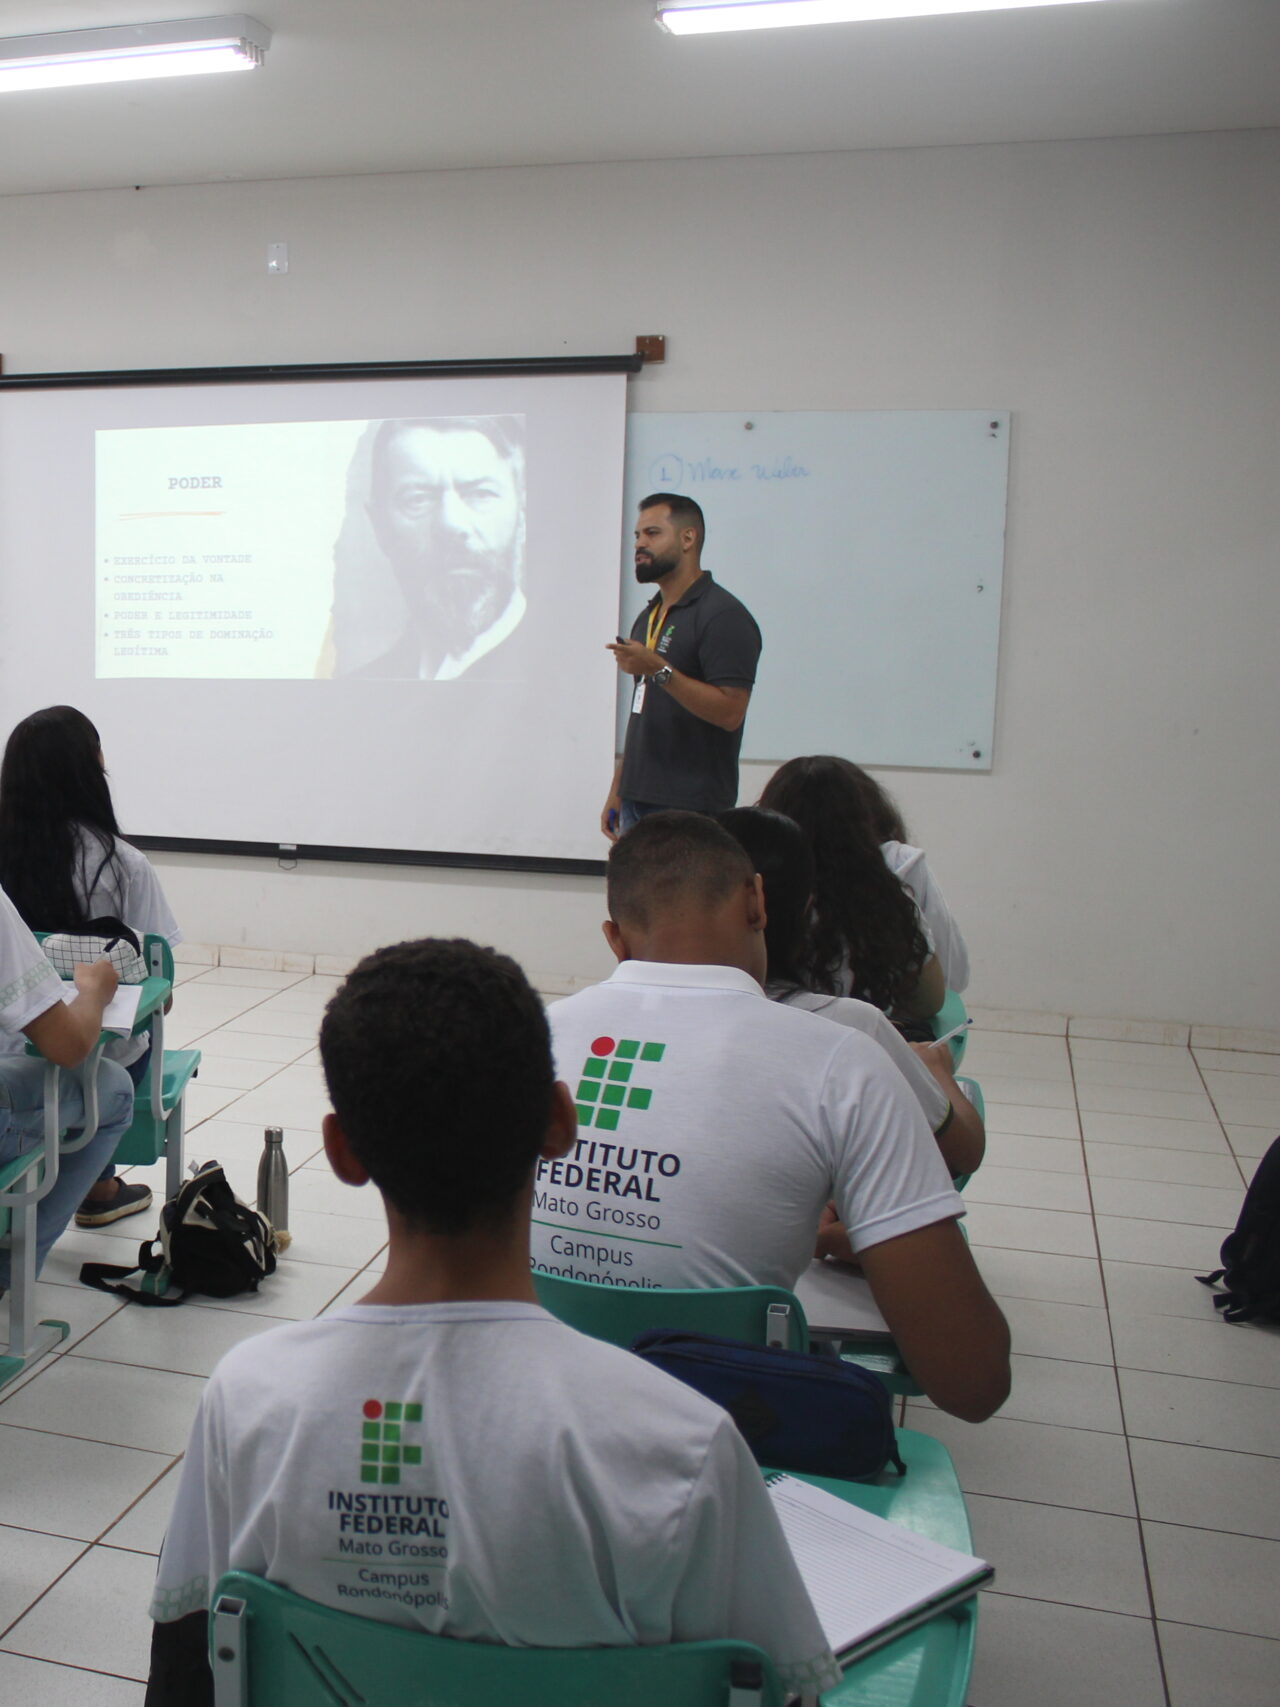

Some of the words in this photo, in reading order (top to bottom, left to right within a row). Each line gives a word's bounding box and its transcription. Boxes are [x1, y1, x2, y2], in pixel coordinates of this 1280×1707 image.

[167, 476, 224, 490] PODER
[113, 555, 176, 566] EXERCÍCIO
[182, 555, 197, 564] DA
[202, 554, 253, 564] VONTADE
[113, 573, 203, 585] CONCRETIZAÇÃO
[210, 574, 224, 583] NA
[113, 590, 183, 601] OBEDIÊNCIA
[113, 611, 148, 620] PODER
[154, 611, 162, 620] E
[168, 610, 253, 620] LEGITIMIDADE
[113, 628, 141, 640] TRÊS
[148, 630, 182, 639] TIPOS
[189, 630, 203, 639] DE
[210, 628, 274, 641] DOMINAÇÃO
[113, 645, 169, 656] LEGÍTIMA
[536, 1159, 661, 1203] FEDERAL
[532, 1190, 579, 1216] Mato
[586, 1201, 661, 1230] Grosso
[550, 1234, 634, 1267] Campus
[328, 1490, 450, 1519] INSTITUTO
[340, 1513, 446, 1538] FEDERAL
[339, 1538, 383, 1556] Mato
[388, 1540, 448, 1559] Grosso
[358, 1568, 430, 1589] Campus
